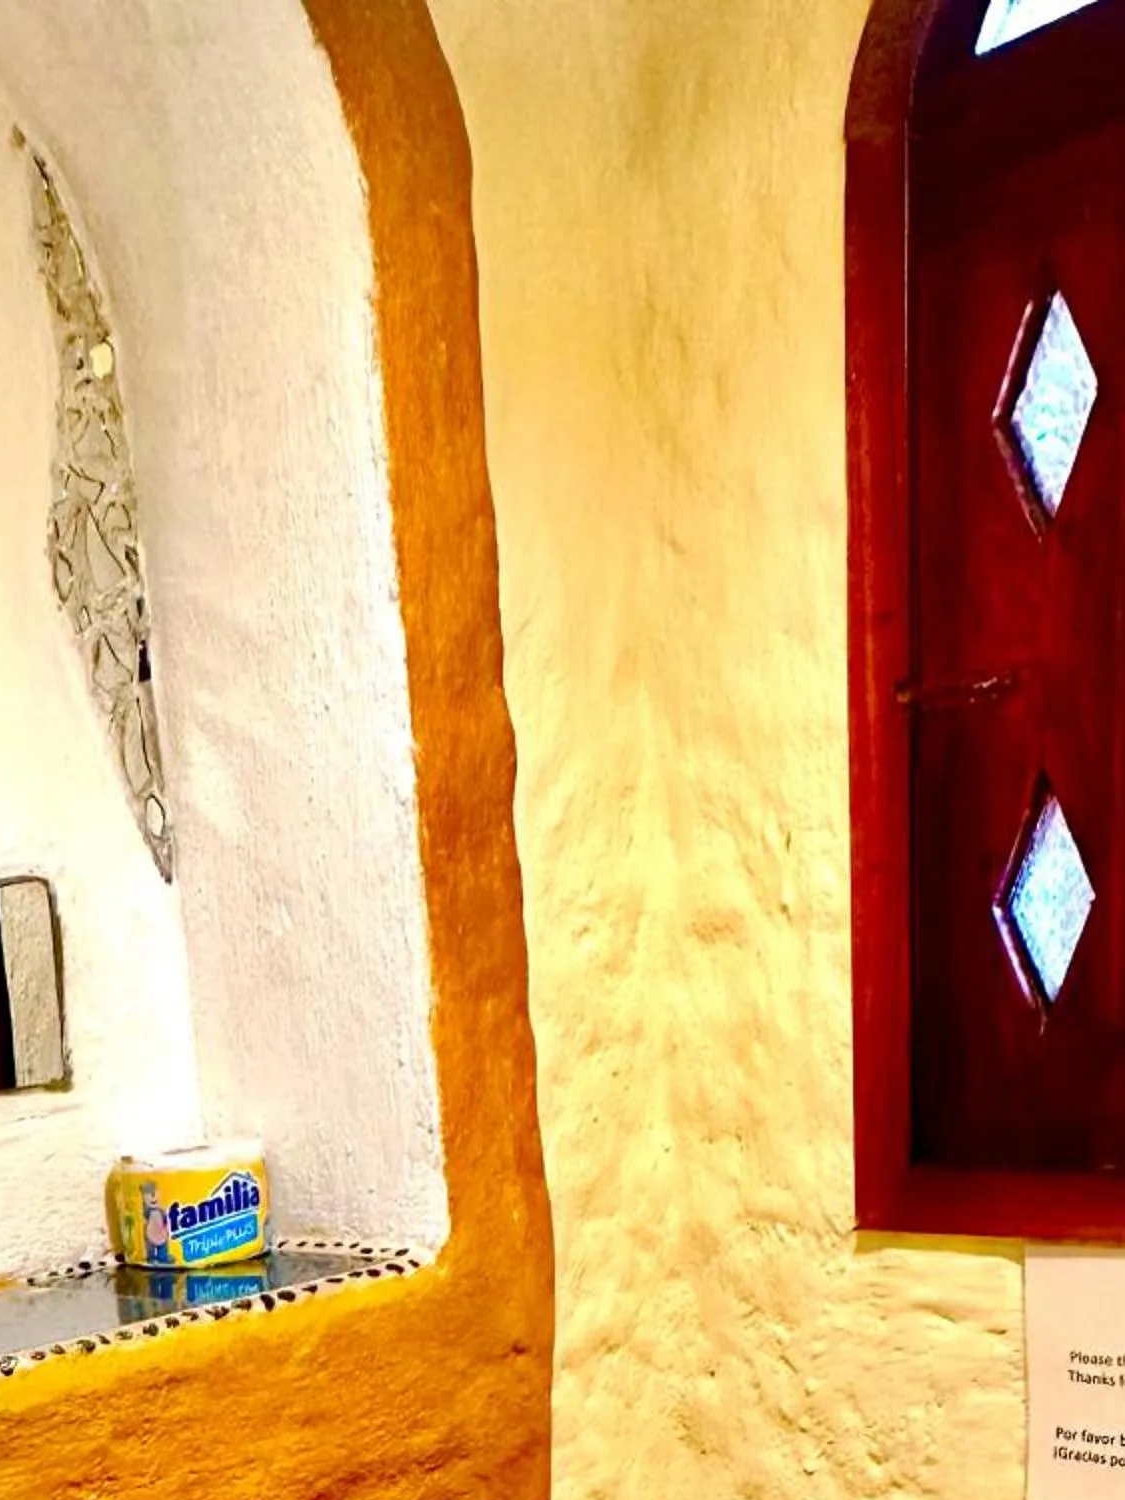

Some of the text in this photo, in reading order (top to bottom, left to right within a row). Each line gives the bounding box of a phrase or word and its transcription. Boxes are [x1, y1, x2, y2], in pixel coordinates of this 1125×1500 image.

[168, 1180, 260, 1232] familia
[1069, 1351, 1113, 1366] Please
[1067, 1369, 1115, 1387] Thanks
[1055, 1426, 1078, 1441] Por
[1081, 1429, 1115, 1446] favor
